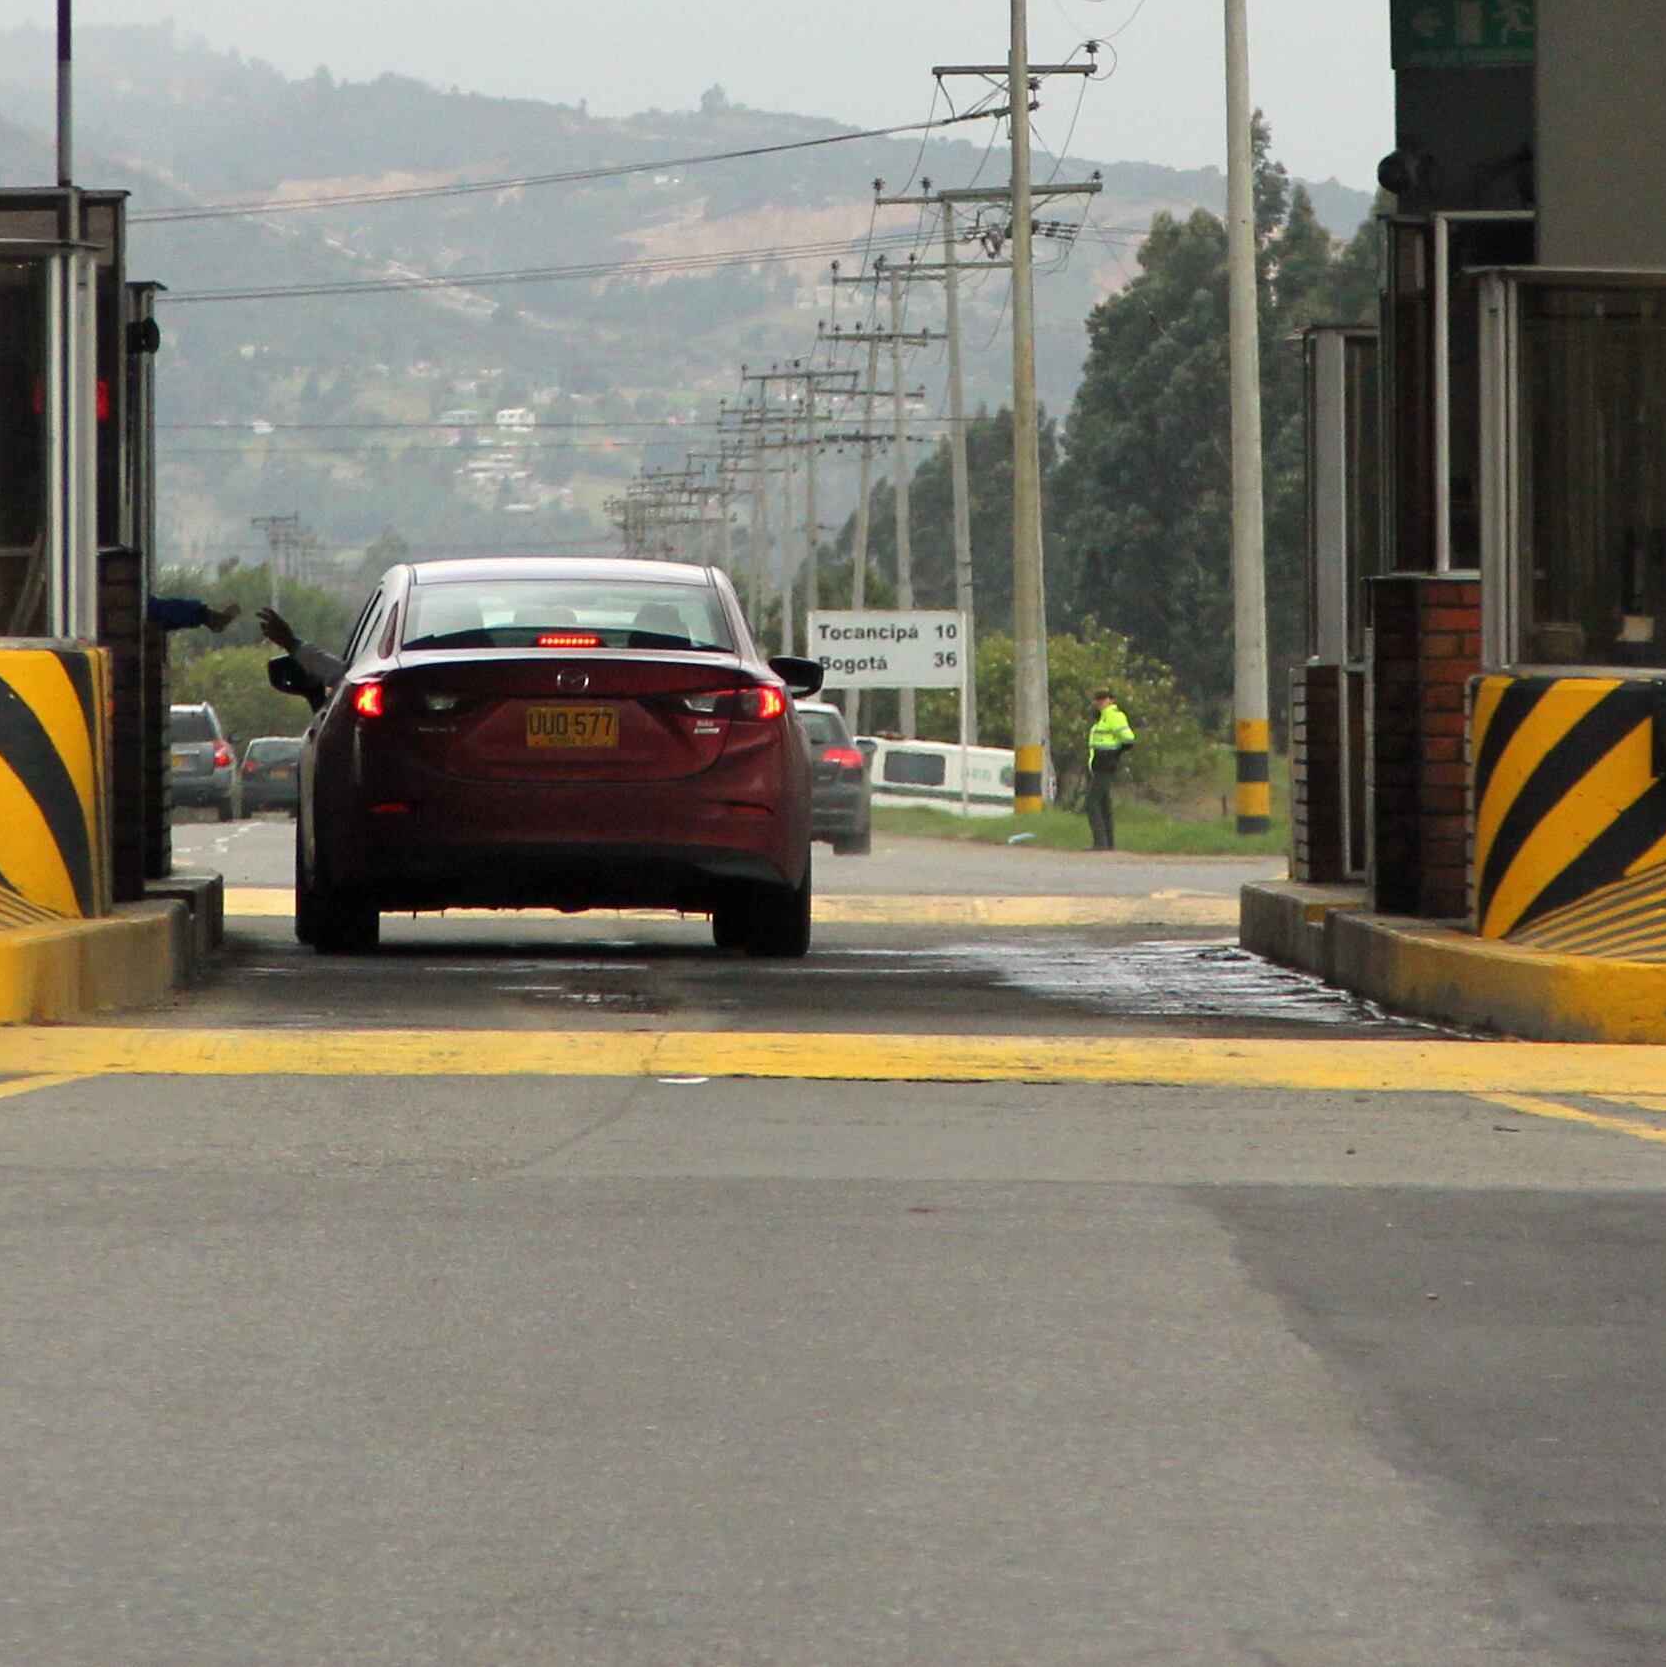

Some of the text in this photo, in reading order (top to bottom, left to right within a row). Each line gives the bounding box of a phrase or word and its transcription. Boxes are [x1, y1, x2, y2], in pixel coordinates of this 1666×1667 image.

[819, 623, 958, 643] Tocancipá 10
[819, 652, 957, 674] Bogotá 36
